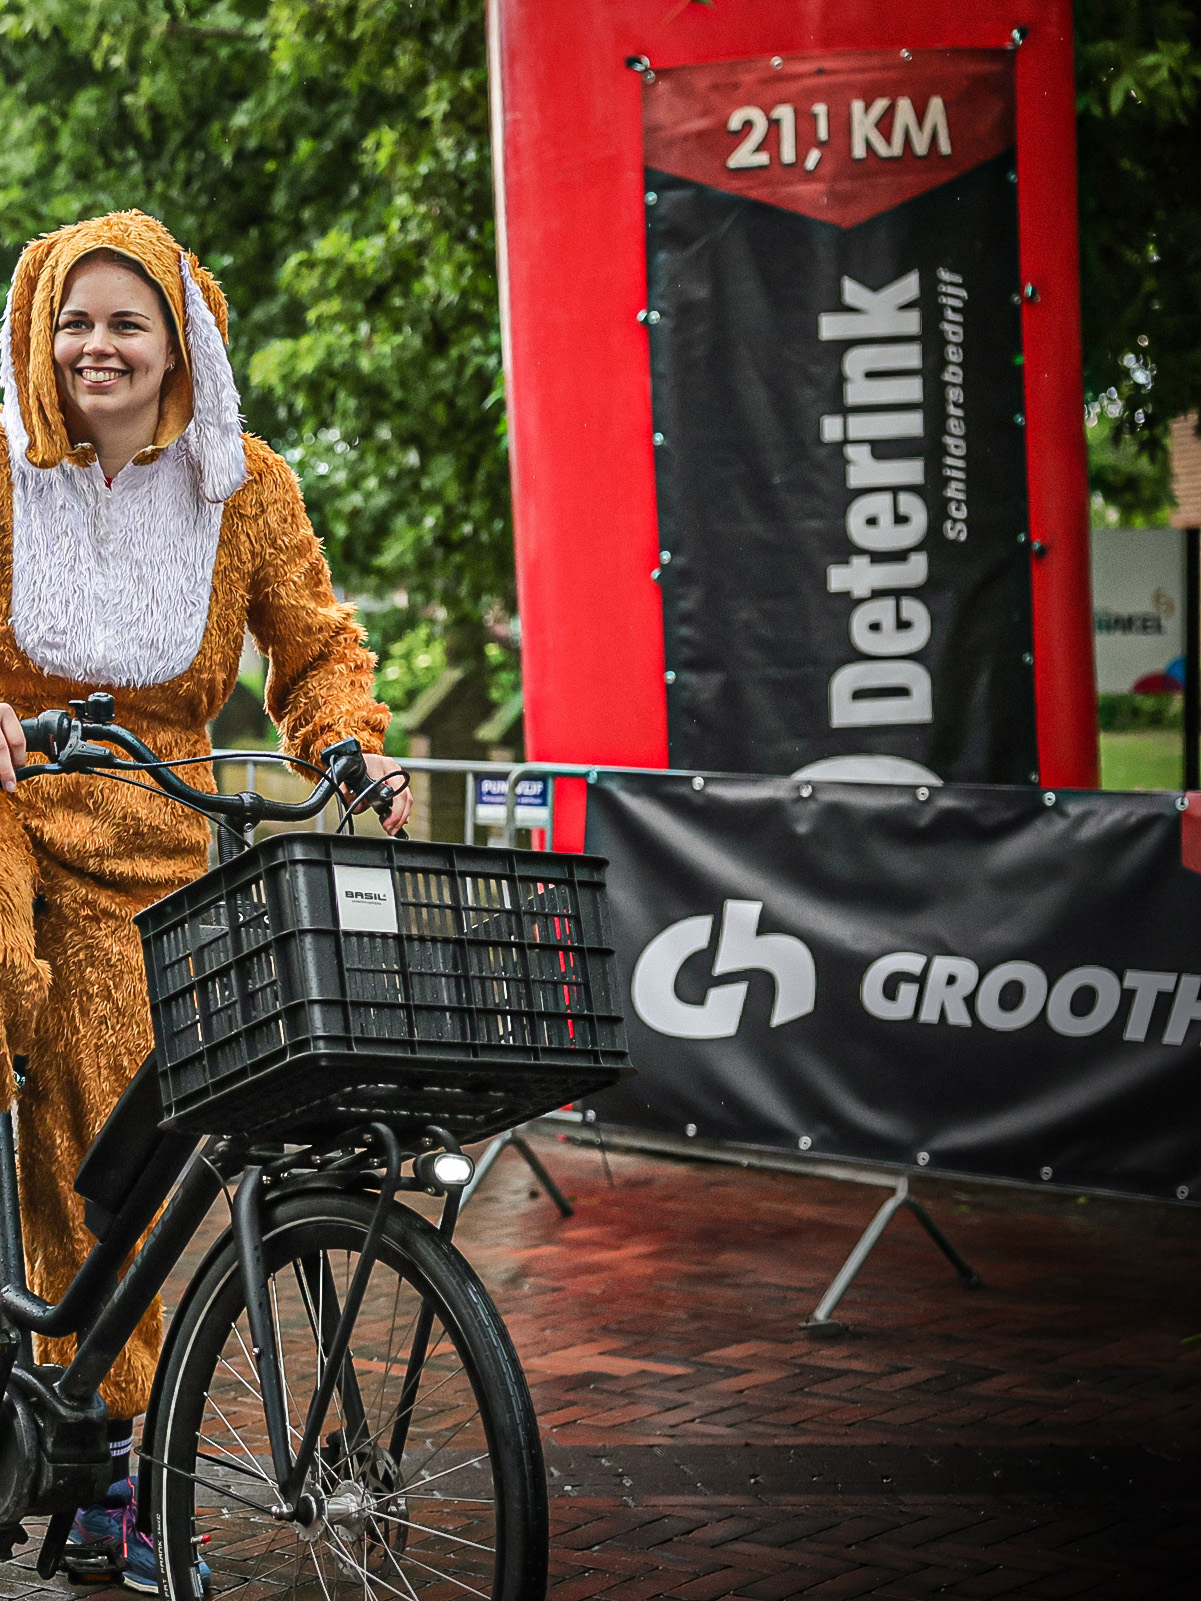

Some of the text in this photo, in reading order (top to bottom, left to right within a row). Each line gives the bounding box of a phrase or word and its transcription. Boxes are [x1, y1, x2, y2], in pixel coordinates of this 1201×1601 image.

[851, 95, 952, 159] KM
[936, 266, 968, 542] Schildersbedrijf
[818, 268, 933, 728] Deterink
[345, 890, 387, 901] BASIL
